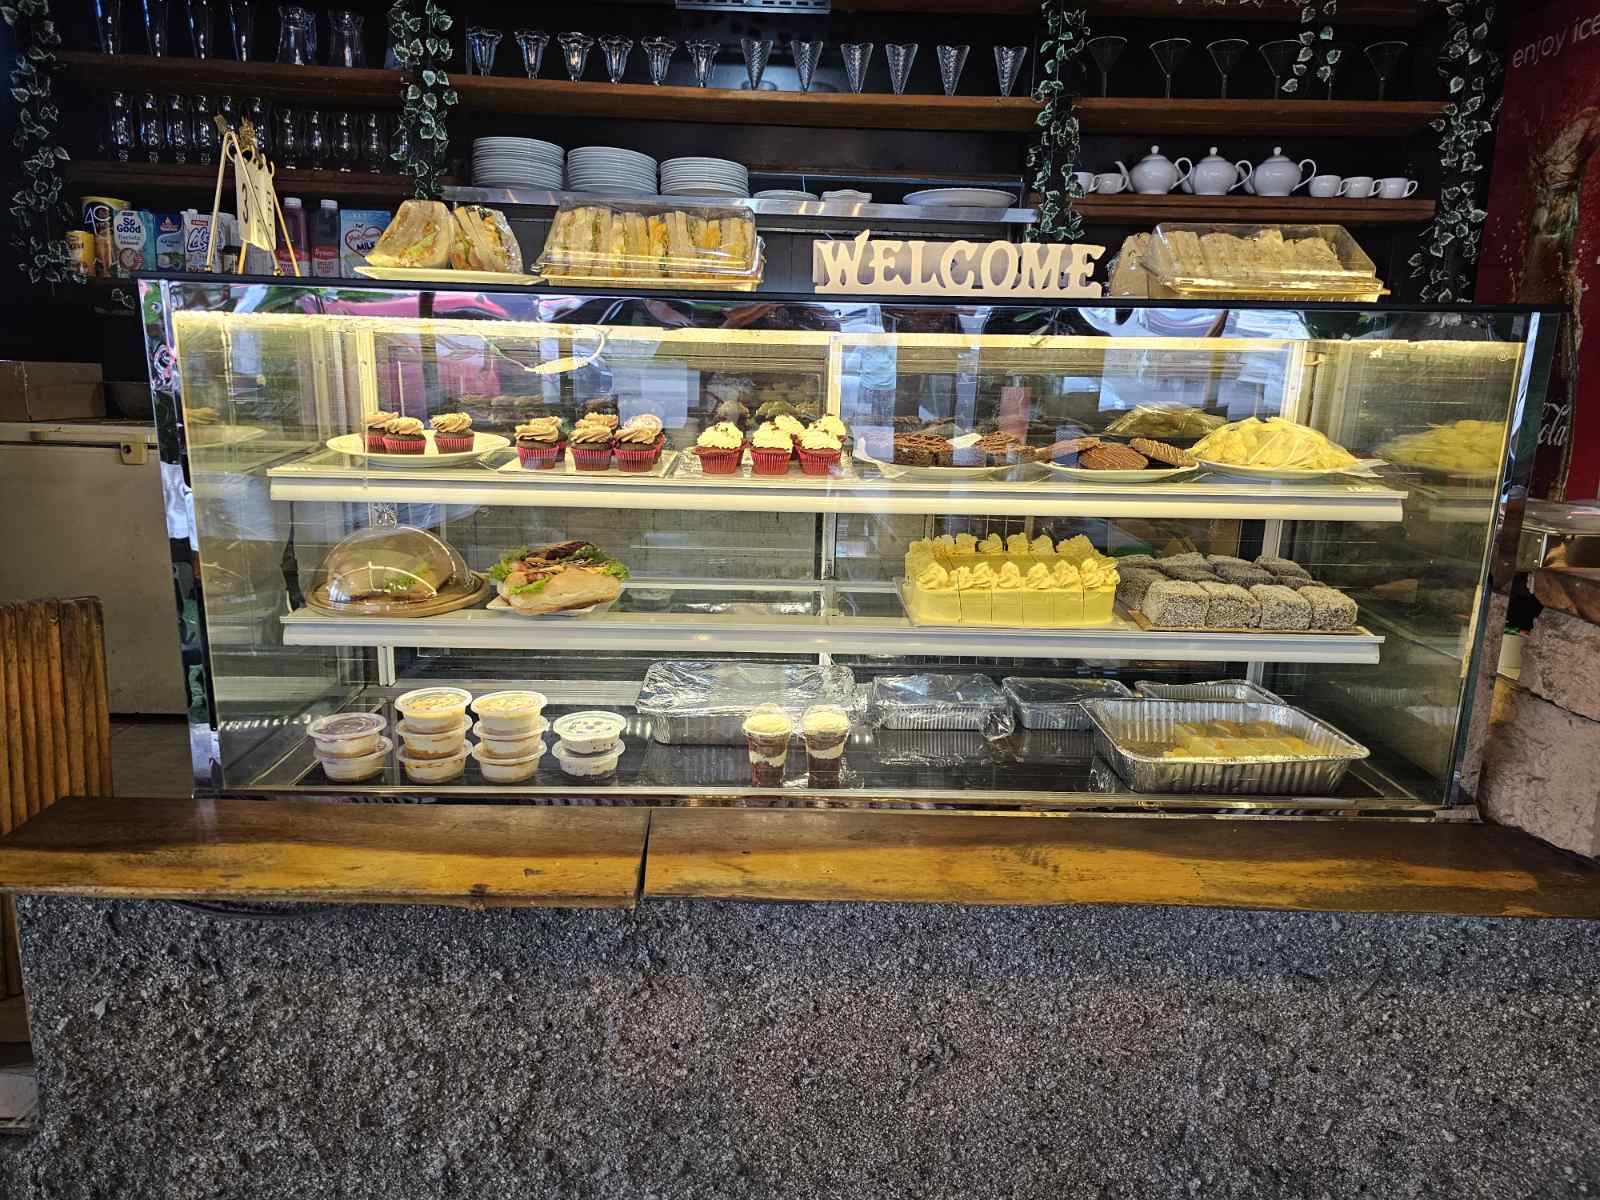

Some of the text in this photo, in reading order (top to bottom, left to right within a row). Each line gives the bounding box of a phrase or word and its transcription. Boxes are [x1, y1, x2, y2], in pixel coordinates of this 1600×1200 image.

[1512, 25, 1568, 68] enjoy
[117, 223, 142, 234] Good
[122, 217, 136, 226] So
[816, 229, 1106, 297] WELCOME
